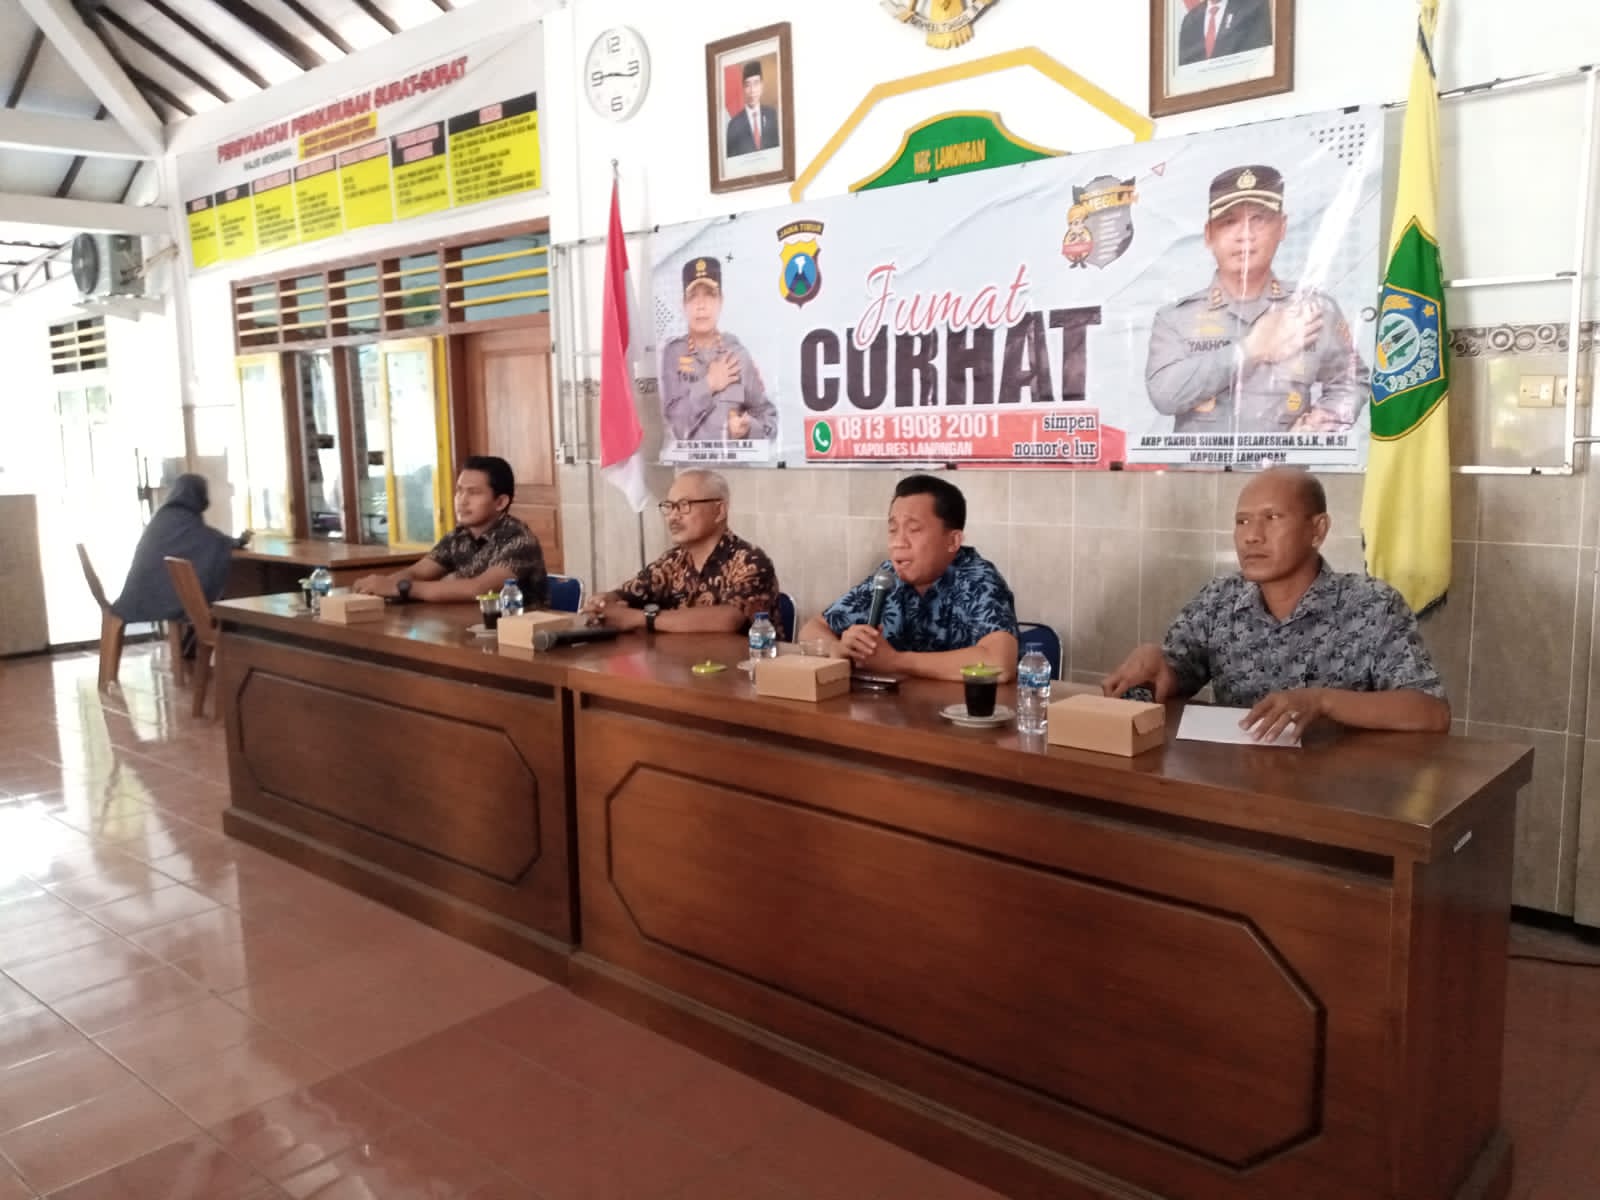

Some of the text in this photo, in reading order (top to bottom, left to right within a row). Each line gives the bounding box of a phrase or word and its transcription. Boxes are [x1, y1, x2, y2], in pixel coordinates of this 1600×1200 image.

[607, 35, 621, 54] 12
[627, 59, 640, 77] 3
[591, 70, 604, 87] 9
[610, 95, 624, 113] 6
[935, 138, 986, 171] LAMONGAN
[855, 264, 1029, 347] Jumat
[800, 305, 1103, 412] CURHAT
[838, 412, 1000, 441] 0813 1908 2001
[1043, 414, 1096, 433] simpen
[853, 442, 909, 457] KAPOLRES
[1074, 440, 1096, 456] lur
